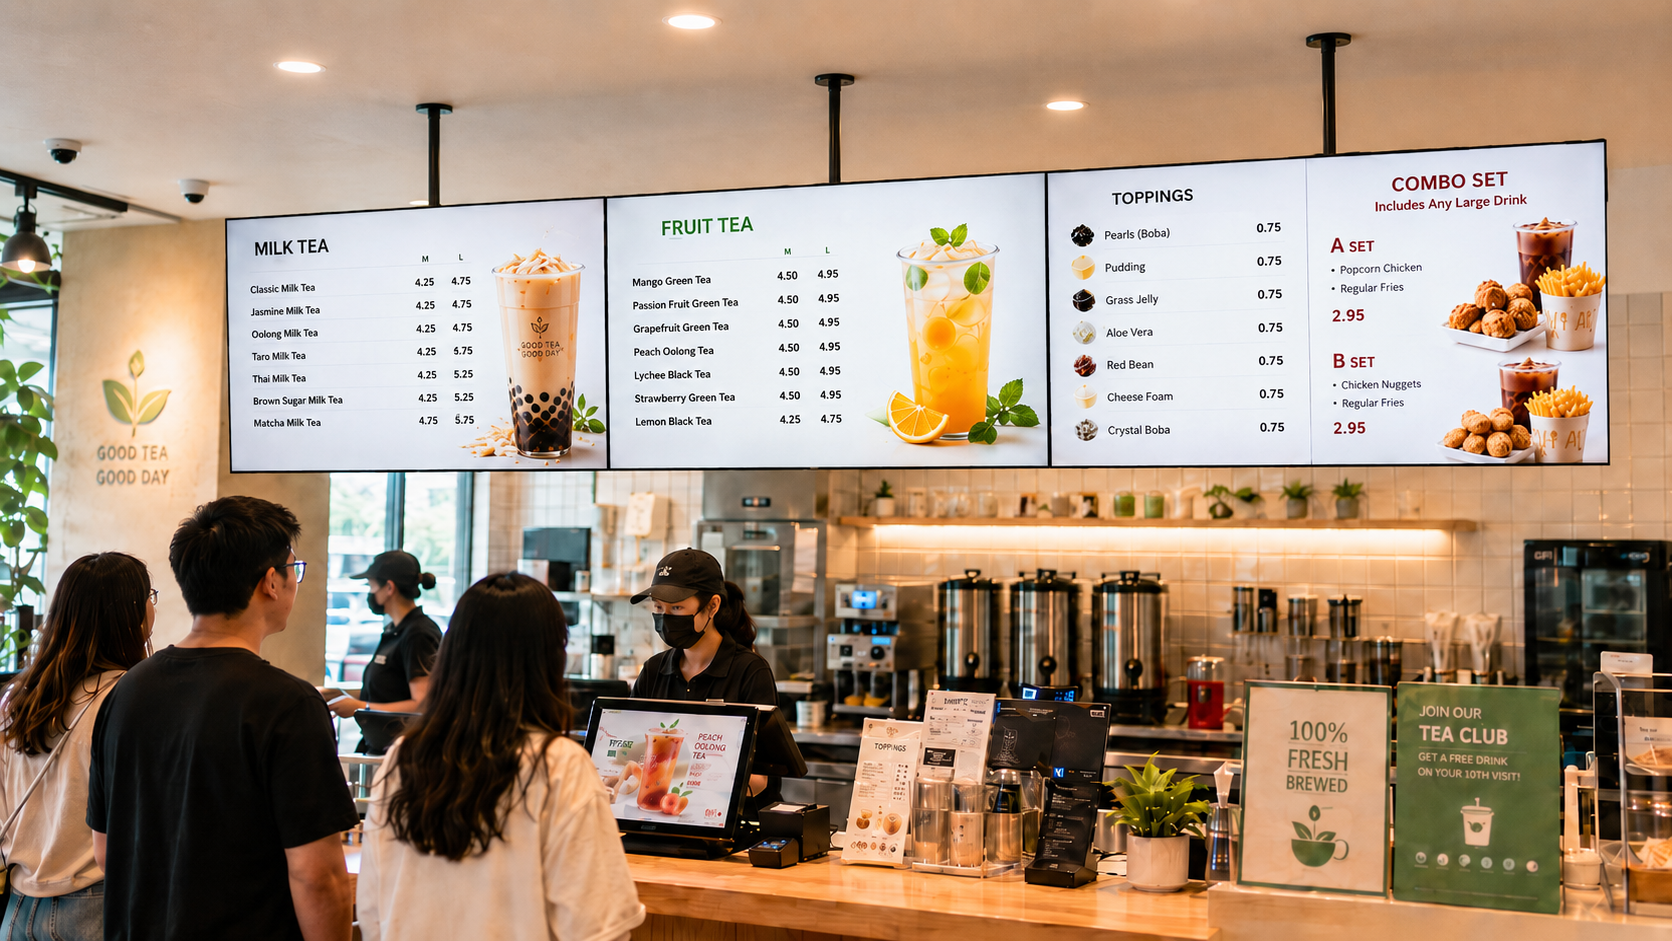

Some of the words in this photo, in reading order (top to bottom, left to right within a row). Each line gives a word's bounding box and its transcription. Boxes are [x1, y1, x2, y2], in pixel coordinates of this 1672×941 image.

[1391, 173, 1466, 193] COMBO
[1472, 171, 1509, 188] SET
[1111, 188, 1194, 206] TOPPINGS
[1375, 199, 1426, 212] Includes
[1428, 198, 1453, 212] Any
[1455, 197, 1491, 210] Large
[1493, 193, 1528, 207] Drink
[661, 217, 714, 236] FRUIT
[716, 215, 754, 233] TEA
[1256, 221, 1282, 234] 0.75
[1104, 229, 1135, 241] Pearls
[1137, 227, 1171, 241] (Boba)
[254, 239, 294, 257] MILK
[296, 238, 330, 254] TEA
[784, 247, 792, 256] M
[825, 246, 831, 254] L
[1330, 237, 1345, 254] A
[1348, 240, 1375, 253] SET
[421, 254, 430, 263] M
[458, 253, 464, 262] L
[1256, 255, 1282, 267] 0.75
[1105, 261, 1146, 274] Pudding
[1340, 265, 1381, 277] Popcorn
[1382, 262, 1423, 274] Chicken
[776, 270, 798, 281] 4.50
[817, 268, 839, 279] 4.95
[414, 277, 435, 287] 4.25
[451, 276, 471, 286] 4.75
[632, 277, 664, 289] Mango
[664, 276, 694, 286] Green
[694, 275, 712, 285] Tea
[249, 284, 280, 295] Classic
[280, 283, 299, 293] Milk
[300, 283, 316, 292] Tea
[1257, 288, 1283, 300] 0.75
[1340, 283, 1378, 296] Regular
[1380, 282, 1405, 292] Fries
[415, 300, 436, 310] 4.25
[451, 299, 472, 309] 4.75
[632, 300, 667, 311] Passion
[668, 299, 690, 309] Fruit
[691, 298, 721, 309] Green
[721, 297, 739, 307] Tea
[777, 294, 799, 305] 4.50
[817, 293, 840, 303] 4.95
[1105, 295, 1134, 306] Grass
[1135, 293, 1159, 306] Jelly
[250, 306, 285, 317] Jasmine
[285, 306, 304, 316] Milk
[304, 305, 321, 315] Tea
[1332, 308, 1365, 323] 2.95
[415, 323, 436, 334] 4.25
[452, 322, 473, 333] 4.75
[633, 322, 681, 335] Grapefruit
[682, 322, 711, 333] Green
[712, 321, 730, 331] Tea
[777, 318, 800, 329] 4.50
[818, 317, 840, 327] 4.95
[1257, 322, 1283, 333] 0.75
[251, 329, 283, 341] Oolong
[283, 328, 302, 338] Milk
[303, 328, 319, 338] Tea
[1105, 327, 1129, 338] Aloe
[1129, 327, 1154, 337] Vera
[416, 346, 437, 357] 4.25
[521, 341, 543, 349] GOOD
[545, 341, 560, 349] TEA
[633, 346, 661, 357] Peach
[662, 345, 697, 358] Oolong
[697, 345, 715, 356] Tea
[778, 342, 800, 353] 4.50
[818, 341, 841, 352] 4.95
[251, 352, 271, 362] Taro
[271, 351, 290, 361] Milk
[290, 351, 307, 360] Tea
[521, 350, 543, 358] GOOD
[1258, 355, 1284, 366] 0.75
[1106, 359, 1126, 370] Red
[1128, 359, 1154, 370] Bean
[1333, 353, 1346, 369] B
[1350, 356, 1376, 369] SET
[417, 370, 437, 380] 4.25
[453, 369, 474, 379] 5.25
[634, 370, 666, 383] Lychee
[667, 369, 693, 380] Black
[694, 369, 711, 379] Tea
[778, 366, 800, 377] 4.50
[819, 365, 841, 376] 4.95
[251, 374, 271, 384] Thai
[271, 373, 290, 383] Milk
[291, 373, 307, 383] Tea
[1341, 379, 1380, 390] Chicken
[1381, 379, 1422, 392] Nuggets
[418, 393, 438, 403] 4.25
[454, 392, 475, 402] 5.25
[634, 393, 687, 405] Strawberry
[688, 392, 717, 403] Green
[718, 392, 736, 402] Tea
[779, 390, 801, 401] 4.50
[819, 389, 842, 400] 4.95
[1106, 392, 1144, 403] Cheese
[1145, 391, 1174, 402] Foam
[1259, 388, 1285, 399] 0.75
[253, 396, 281, 406] Brown
[281, 396, 307, 408] Sugar
[308, 395, 327, 405] Milk
[327, 395, 344, 405] Tea
[1342, 398, 1379, 411] Regular
[1381, 397, 1405, 408] Fries
[253, 418, 285, 428] Matcha
[286, 418, 305, 427] Milk
[305, 418, 322, 427] Tea
[418, 415, 439, 425] 4.75
[454, 414, 475, 425] 5.75
[635, 417, 667, 427] Lemon
[668, 416, 694, 426] Black
[695, 416, 713, 426] Tea
[779, 414, 801, 425] 4.25
[820, 413, 843, 424] 4.75
[1107, 424, 1143, 438] Crystal
[1144, 424, 1171, 435] Boba
[1259, 421, 1285, 433] 0.75
[1333, 421, 1366, 435] 2.95
[97, 445, 137, 461] GOOD
[142, 445, 169, 461] TEA
[96, 469, 137, 486] GOOD
[142, 469, 170, 486] DAY
[1418, 704, 1450, 718] JOIN
[1452, 706, 1482, 720] OUR
[697, 732, 724, 742] PEACH
[1290, 720, 1348, 744] 100%
[1418, 724, 1455, 743] TEA
[1459, 726, 1509, 746] CLUB
[874, 742, 907, 752] TOPPINGS
[692, 751, 706, 760] TEA
[1287, 748, 1349, 773] FRESH
[1417, 751, 1438, 762] GET
[1439, 753, 1448, 763] A
[1449, 753, 1474, 765] FREE
[1475, 755, 1508, 766] DRINK
[1417, 766, 1433, 777] ON
[1434, 768, 1463, 779] YOUR
[1464, 769, 1490, 780] 10TH
[1491, 771, 1521, 782] VISIT!
[1286, 774, 1349, 793] BREWED
